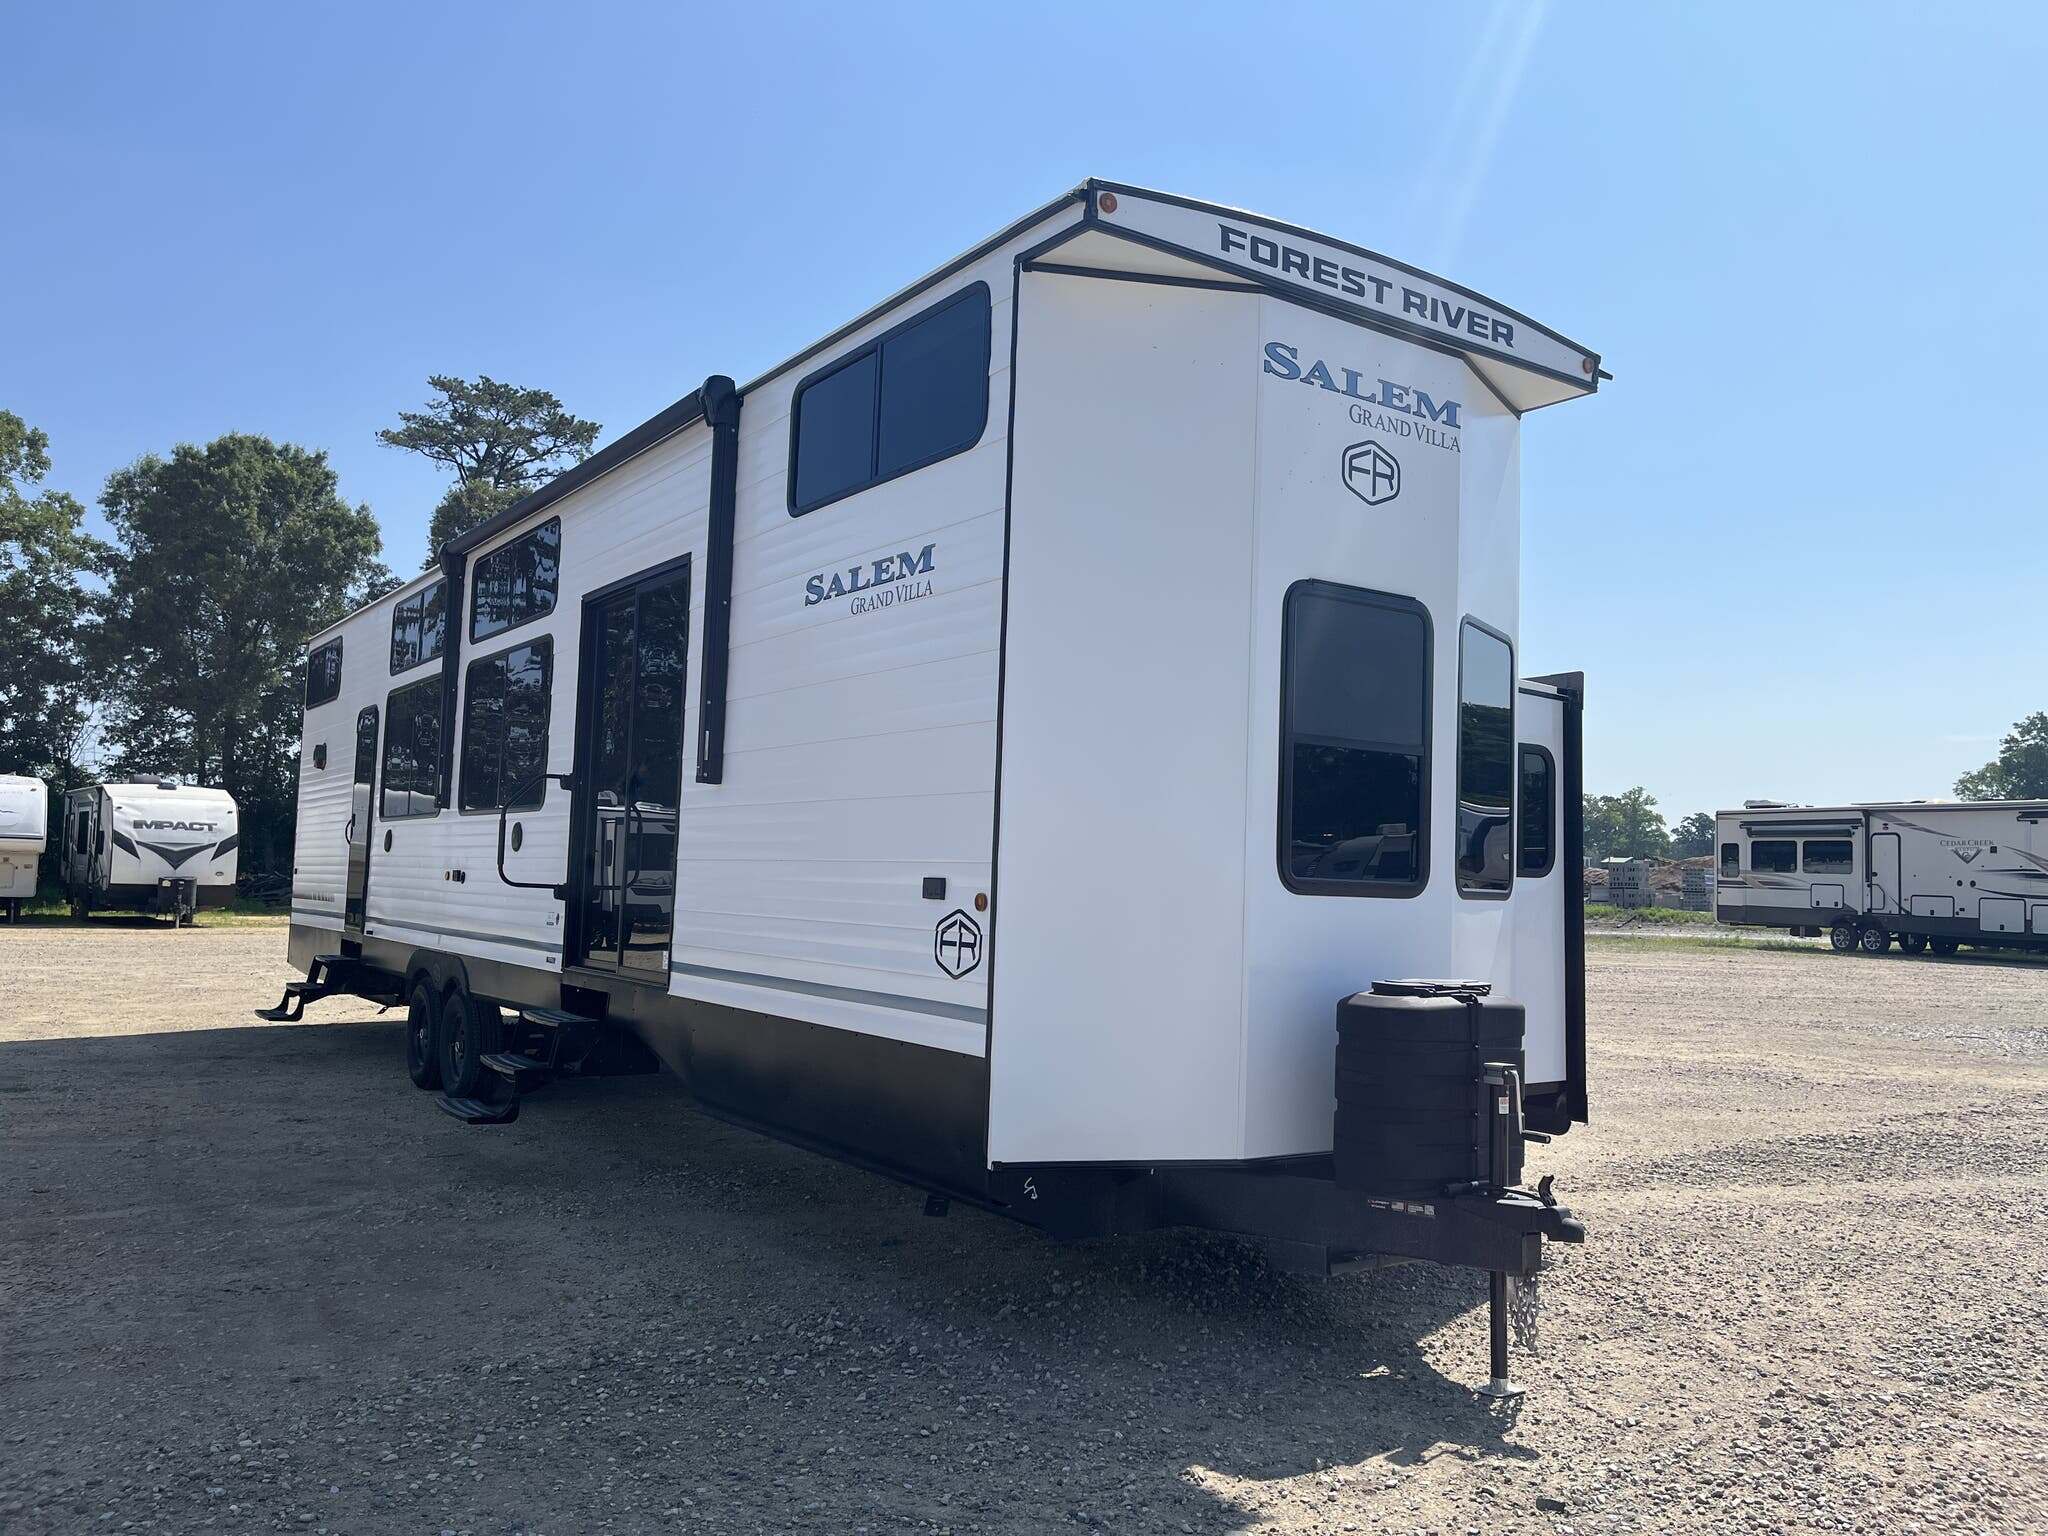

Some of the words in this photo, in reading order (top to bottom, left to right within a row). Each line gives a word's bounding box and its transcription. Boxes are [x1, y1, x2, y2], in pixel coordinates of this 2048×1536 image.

[1217, 223, 1392, 305] FOREST
[1401, 286, 1515, 348] RIVER
[1263, 342, 1462, 429] SALEM
[1349, 403, 1411, 437] GRAND
[1413, 421, 1461, 453] VILLA
[804, 543, 936, 607] SALEM
[850, 589, 894, 615] GRAND
[895, 579, 933, 603] VILLA
[133, 819, 218, 832] IMPACT
